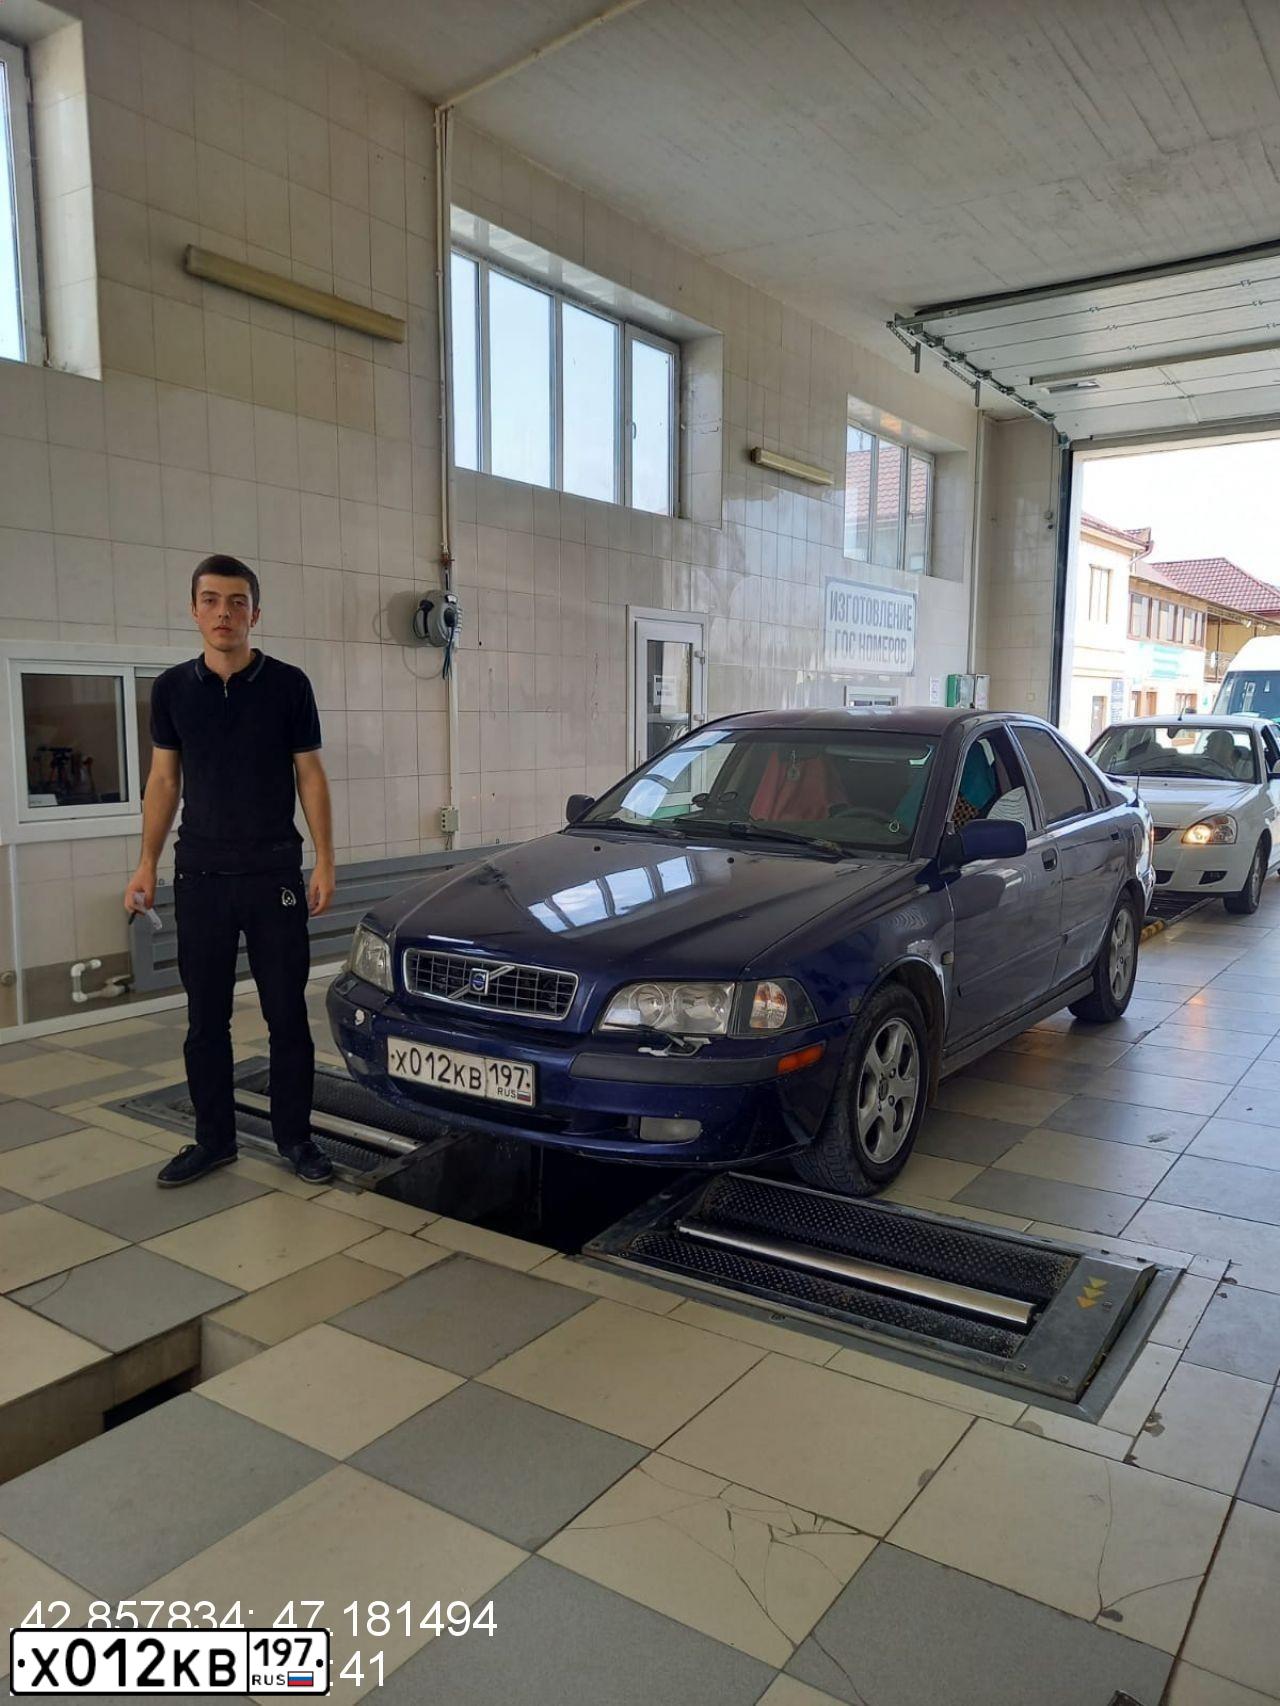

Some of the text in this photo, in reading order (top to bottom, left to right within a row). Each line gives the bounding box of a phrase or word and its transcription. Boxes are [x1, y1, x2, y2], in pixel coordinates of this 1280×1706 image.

[830, 590, 912, 631] ИЗГОТОВЛЕНИЕ
[834, 629, 907, 664] ГОС НОМЕРОВ
[489, 1062, 525, 1088] 197
[497, 1086, 516, 1099] RUS
